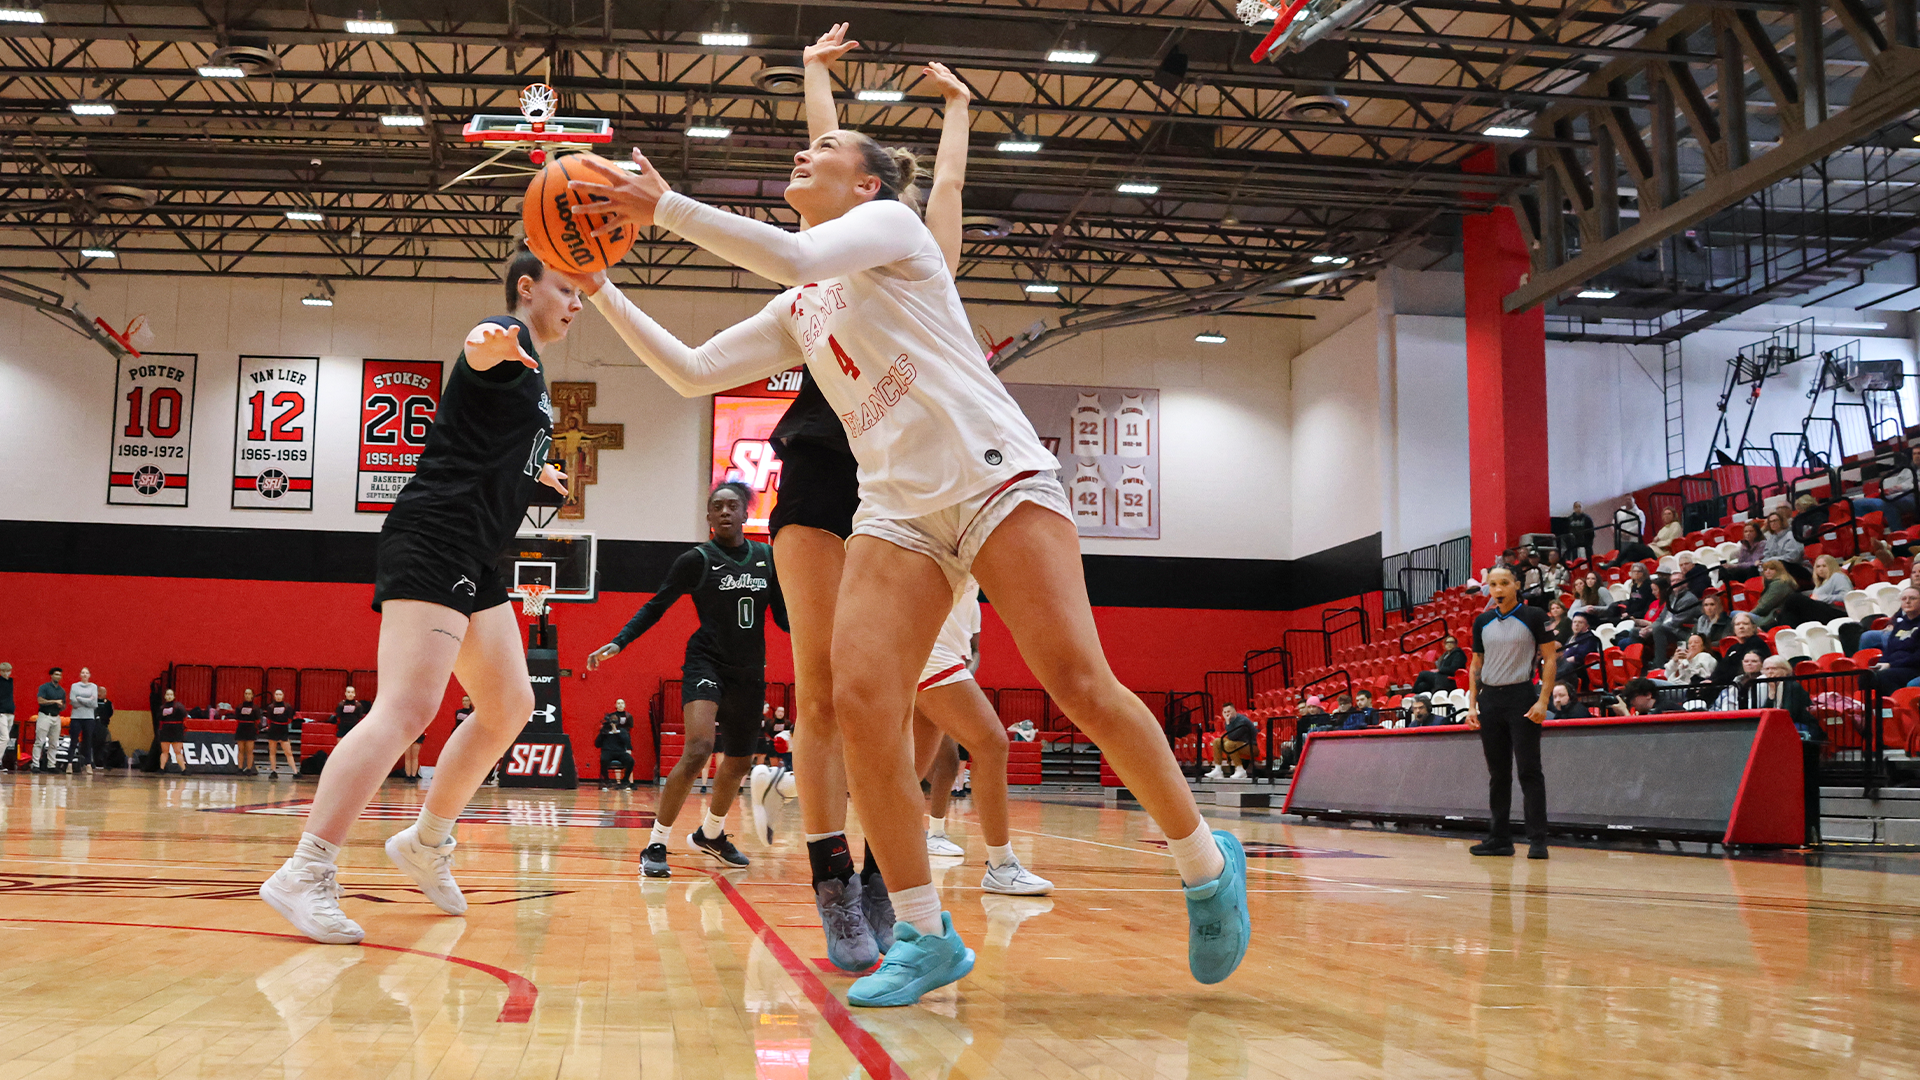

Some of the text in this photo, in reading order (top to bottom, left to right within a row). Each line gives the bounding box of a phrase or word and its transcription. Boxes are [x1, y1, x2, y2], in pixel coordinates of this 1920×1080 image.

[828, 333, 861, 381] 4
[129, 365, 184, 382] PORTER
[250, 369, 307, 386] VAN LIER
[373, 372, 431, 389] STOKES
[124, 386, 183, 439] 10
[247, 390, 305, 442] 12
[364, 393, 437, 446] 26
[1079, 421, 1098, 435] 22
[1126, 423, 1138, 436] 11
[118, 444, 184, 458] 1968-1972
[241, 448, 307, 461] 1965-1969
[139, 475, 159, 485] SFU
[262, 478, 282, 489] SFU
[1078, 491, 1098, 506] 42
[1124, 493, 1144, 507] 52
[737, 596, 754, 629] 0
[507, 743, 564, 776] SFU
